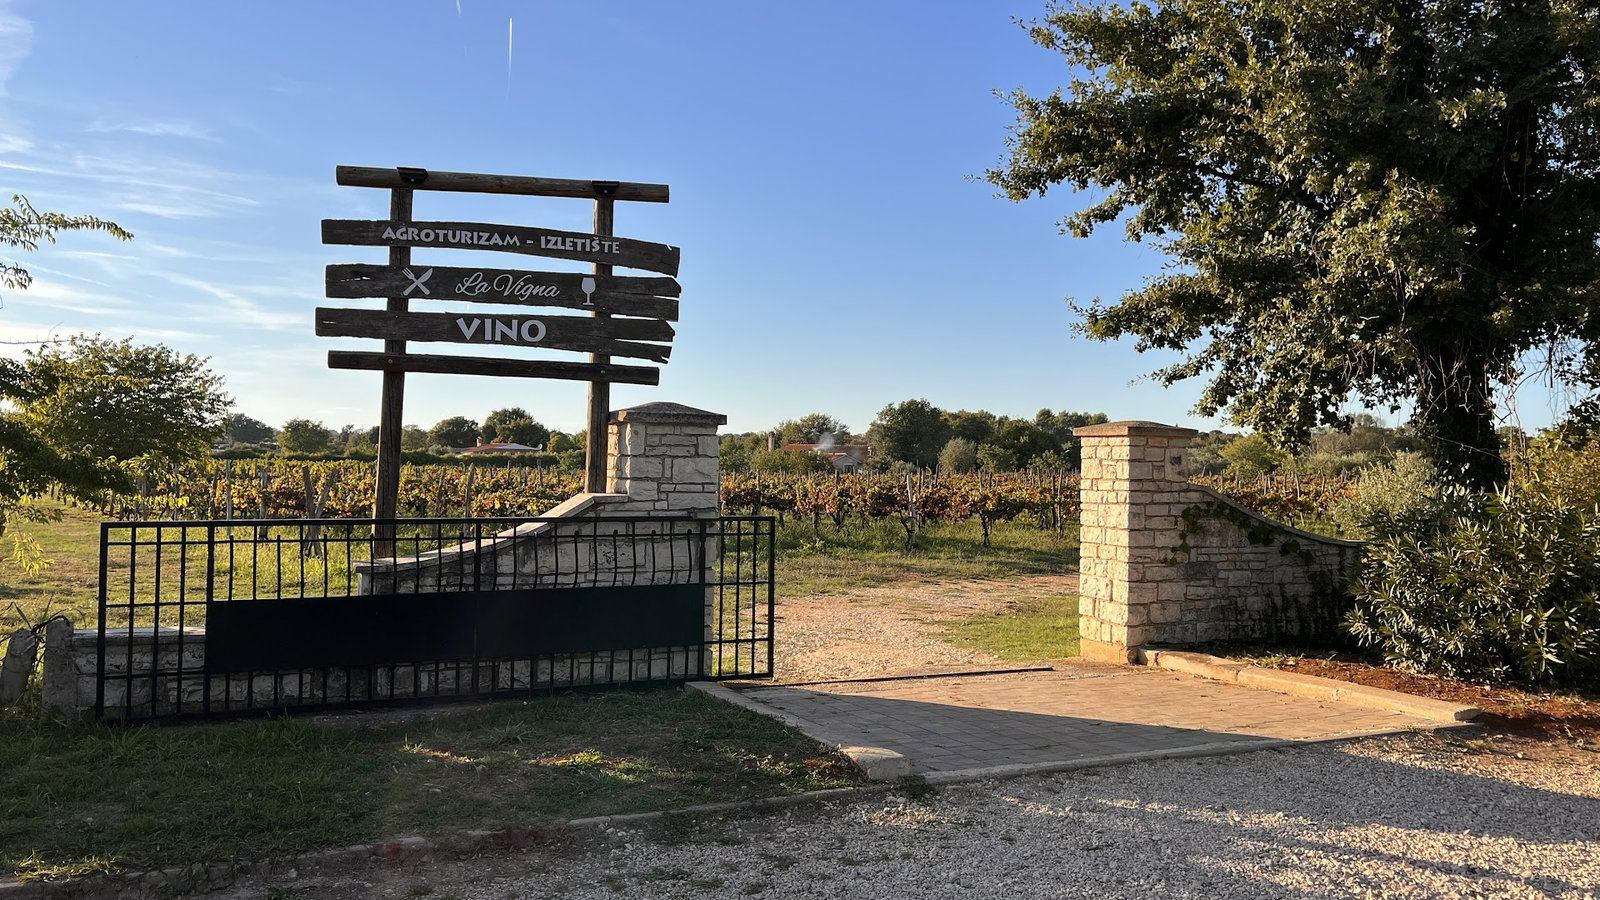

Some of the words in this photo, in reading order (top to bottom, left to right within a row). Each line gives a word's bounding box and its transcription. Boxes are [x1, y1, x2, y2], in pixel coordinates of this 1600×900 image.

[381, 226, 520, 246] AGROTURIZAM
[540, 236, 620, 254] IZLETIŠTE
[455, 271, 491, 295] La
[494, 274, 560, 301] Vigna
[456, 317, 547, 342] VINO
